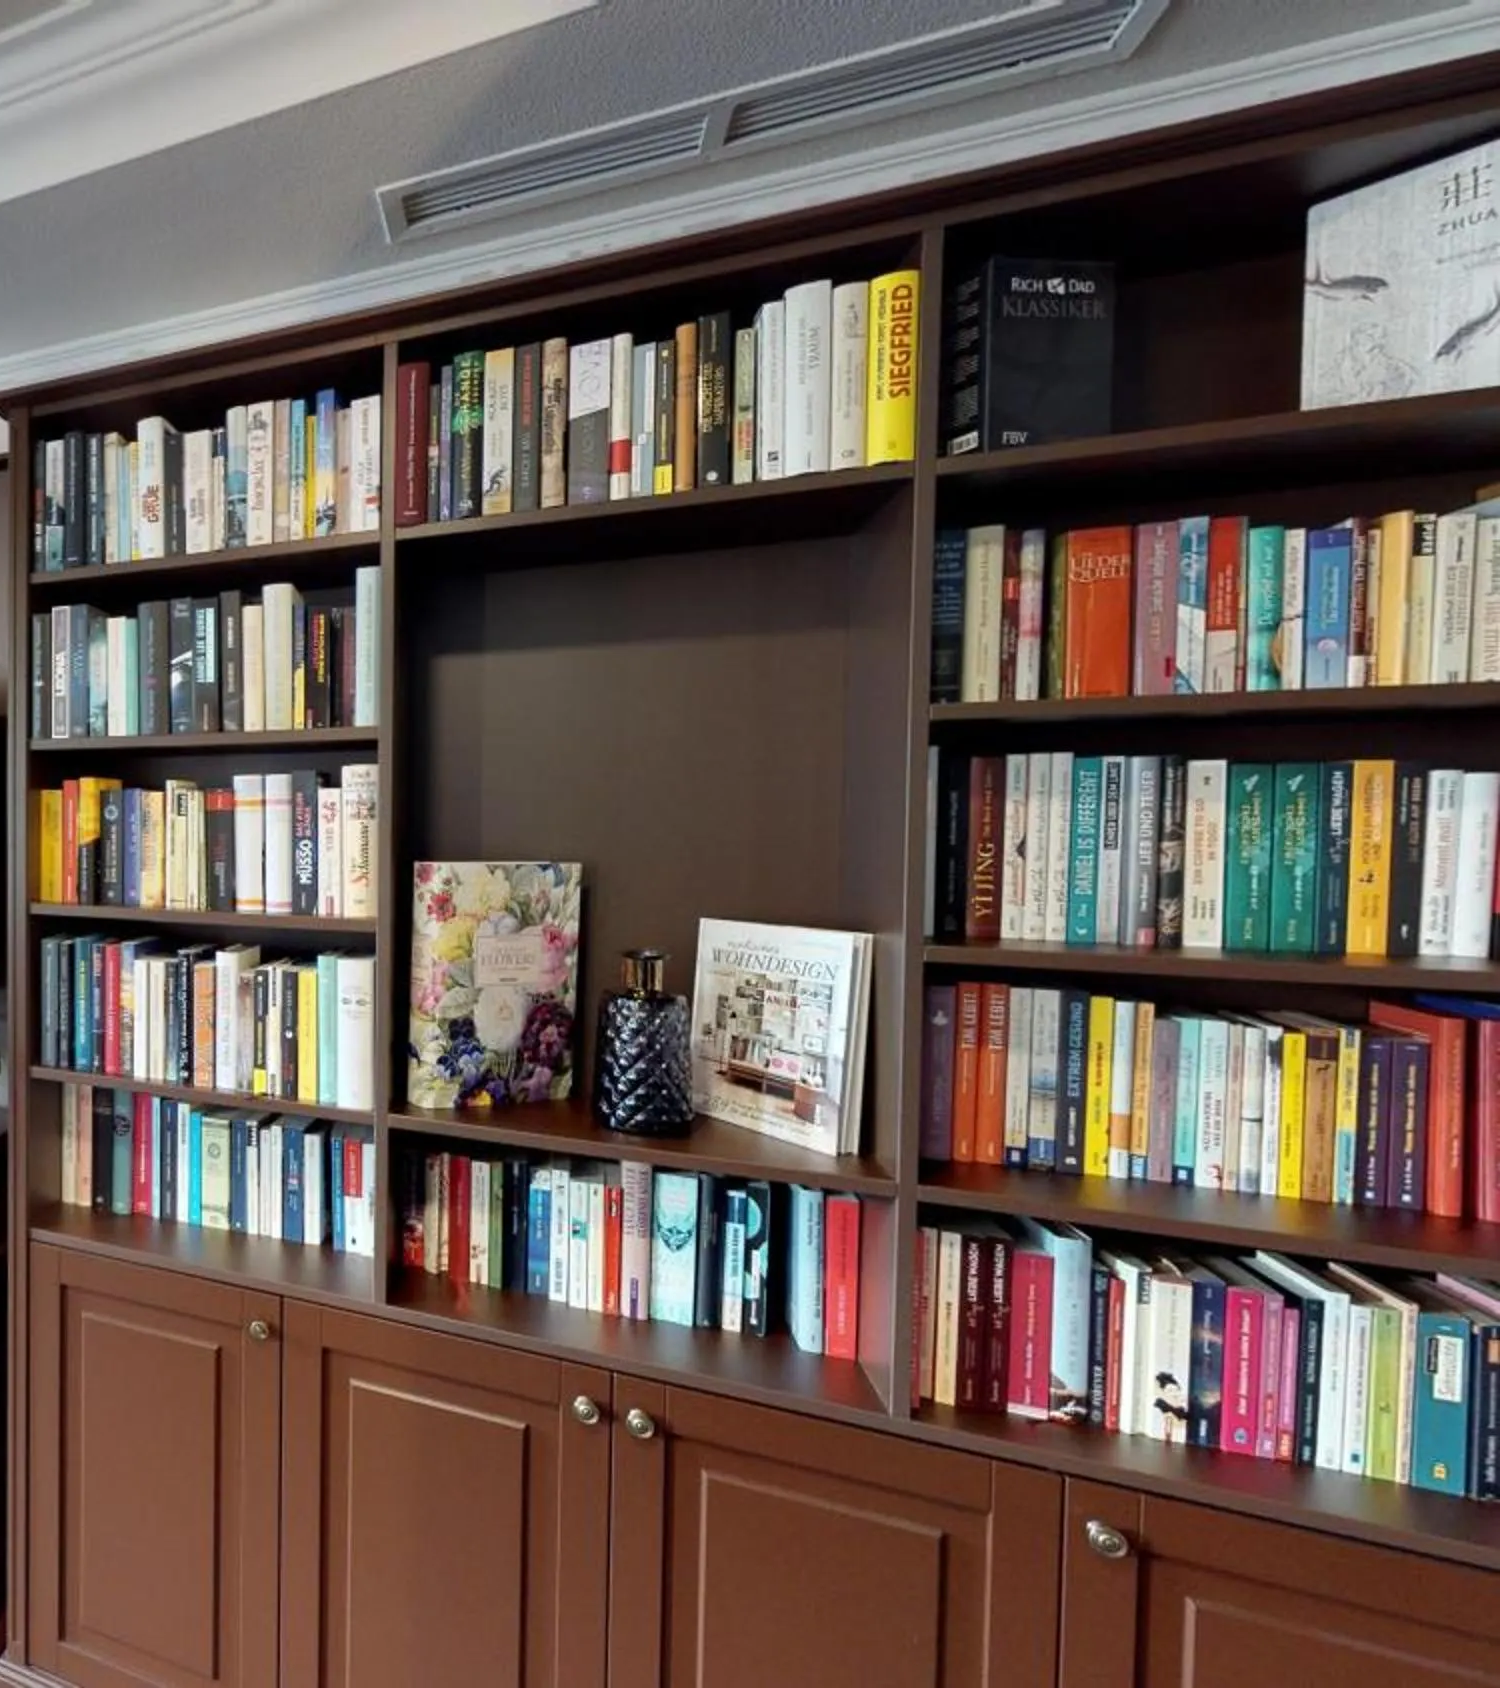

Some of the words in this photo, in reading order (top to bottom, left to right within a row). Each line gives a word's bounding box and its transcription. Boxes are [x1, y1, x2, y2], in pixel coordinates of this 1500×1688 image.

[1069, 279, 1095, 293] DAD
[1002, 296, 1108, 319] KLASSIKER
[888, 284, 913, 399] SIEGFRIED
[1421, 523, 1435, 555] PIPER
[1076, 769, 1097, 834] DIFFERENT
[1140, 769, 1155, 808] TEUER
[1139, 811, 1153, 837] UND
[1075, 838, 1094, 849] IS
[1138, 840, 1152, 865] LIEB
[299, 839, 313, 885] MUSSO
[1073, 854, 1094, 895] DANIEL
[711, 947, 840, 981] WOHNDESIGN
[1067, 1051, 1081, 1097] EXTREM
